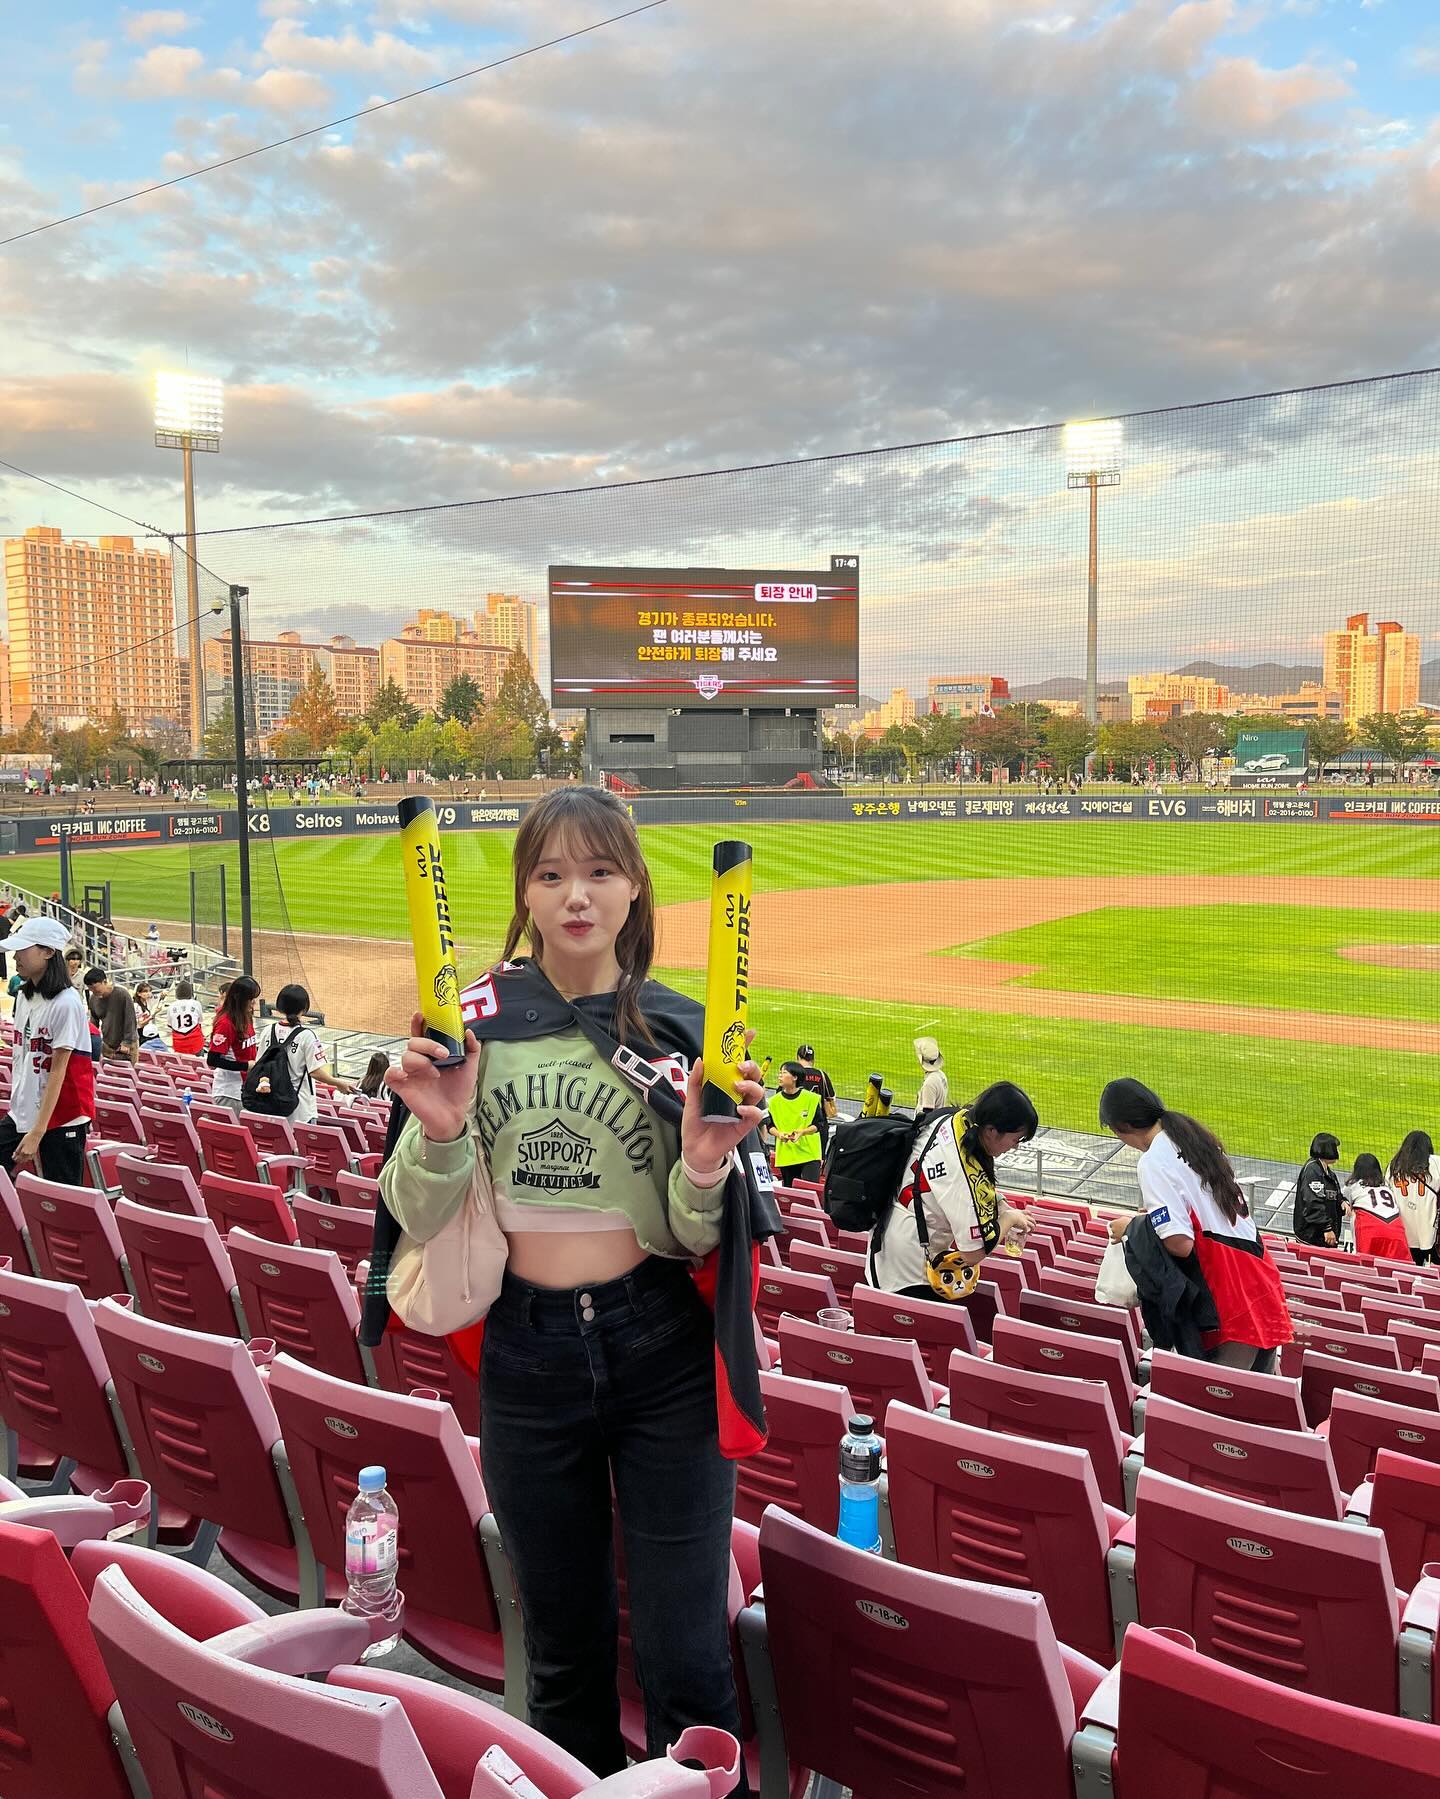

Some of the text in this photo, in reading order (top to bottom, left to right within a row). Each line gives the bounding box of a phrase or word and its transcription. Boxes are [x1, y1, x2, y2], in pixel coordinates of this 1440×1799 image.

[761, 586, 813, 599] 퇴장 안내
[637, 611, 777, 627] 경기가 종료되었습니다.
[670, 629, 763, 645] 여러분들께서는
[637, 646, 778, 662] 안전하게 퇴장해 주세요
[851, 802, 901, 816] 광주은행
[1080, 801, 1133, 813] 지에이건설
[1148, 800, 1187, 816] EV6
[1216, 800, 1256, 817] 해비치
[1344, 801, 1387, 812] 인크커피
[50, 822, 94, 837] 인크커피
[114, 818, 147, 833] COFFEE
[295, 813, 343, 829] Seltos
[173, 826, 218, 835] 02-2016-0100
[176, 1014, 193, 1028] 13
[518, 1140, 597, 1167] SUPPORT
[1367, 1188, 1395, 1209] 19
[959, 1460, 994, 1475] 117-17-06
[1230, 1538, 1270, 1556] 117-17-05
[859, 1600, 907, 1628] 117-18-06
[182, 1704, 230, 1738] 117-19-06
